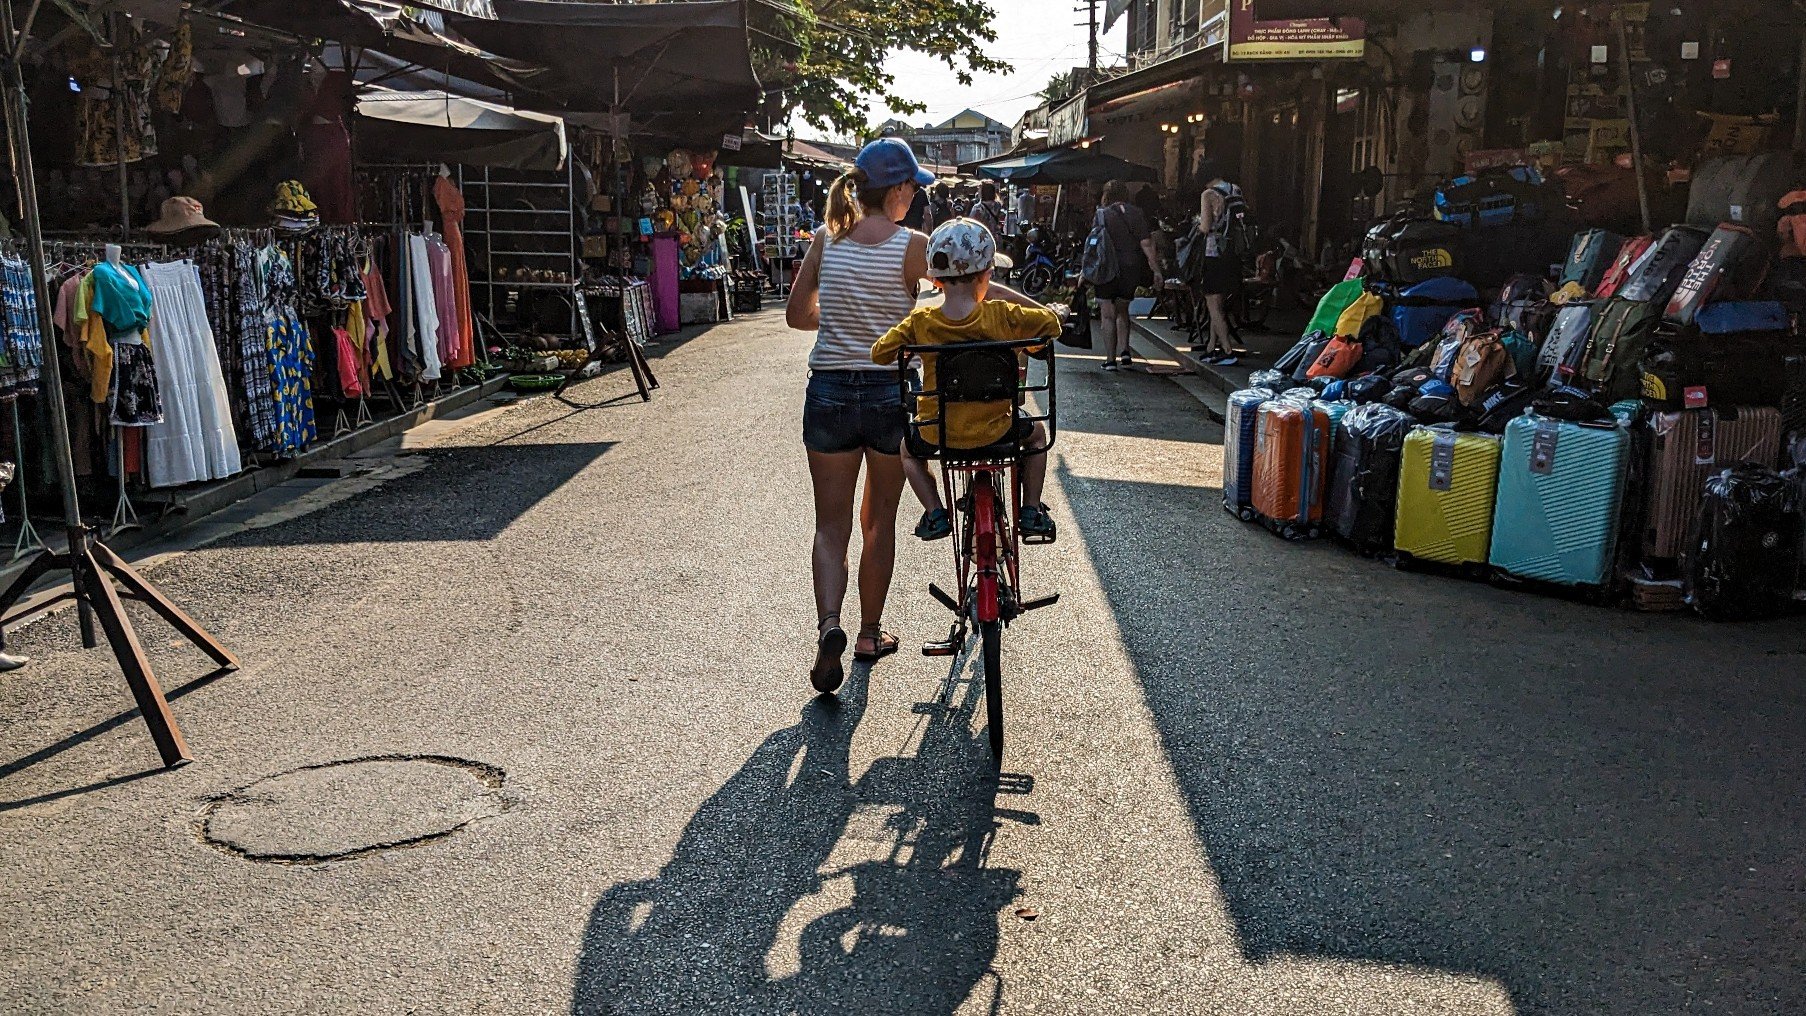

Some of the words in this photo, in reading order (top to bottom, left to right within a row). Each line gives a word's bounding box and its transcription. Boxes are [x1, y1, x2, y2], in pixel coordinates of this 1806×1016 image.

[1411, 255, 1437, 264] NORTH
[1421, 249, 1437, 257] THE
[1418, 261, 1438, 270] FACE
[1684, 239, 1722, 288] NORTH
[1691, 263, 1716, 291] THE
[1482, 391, 1505, 411] NIKE
